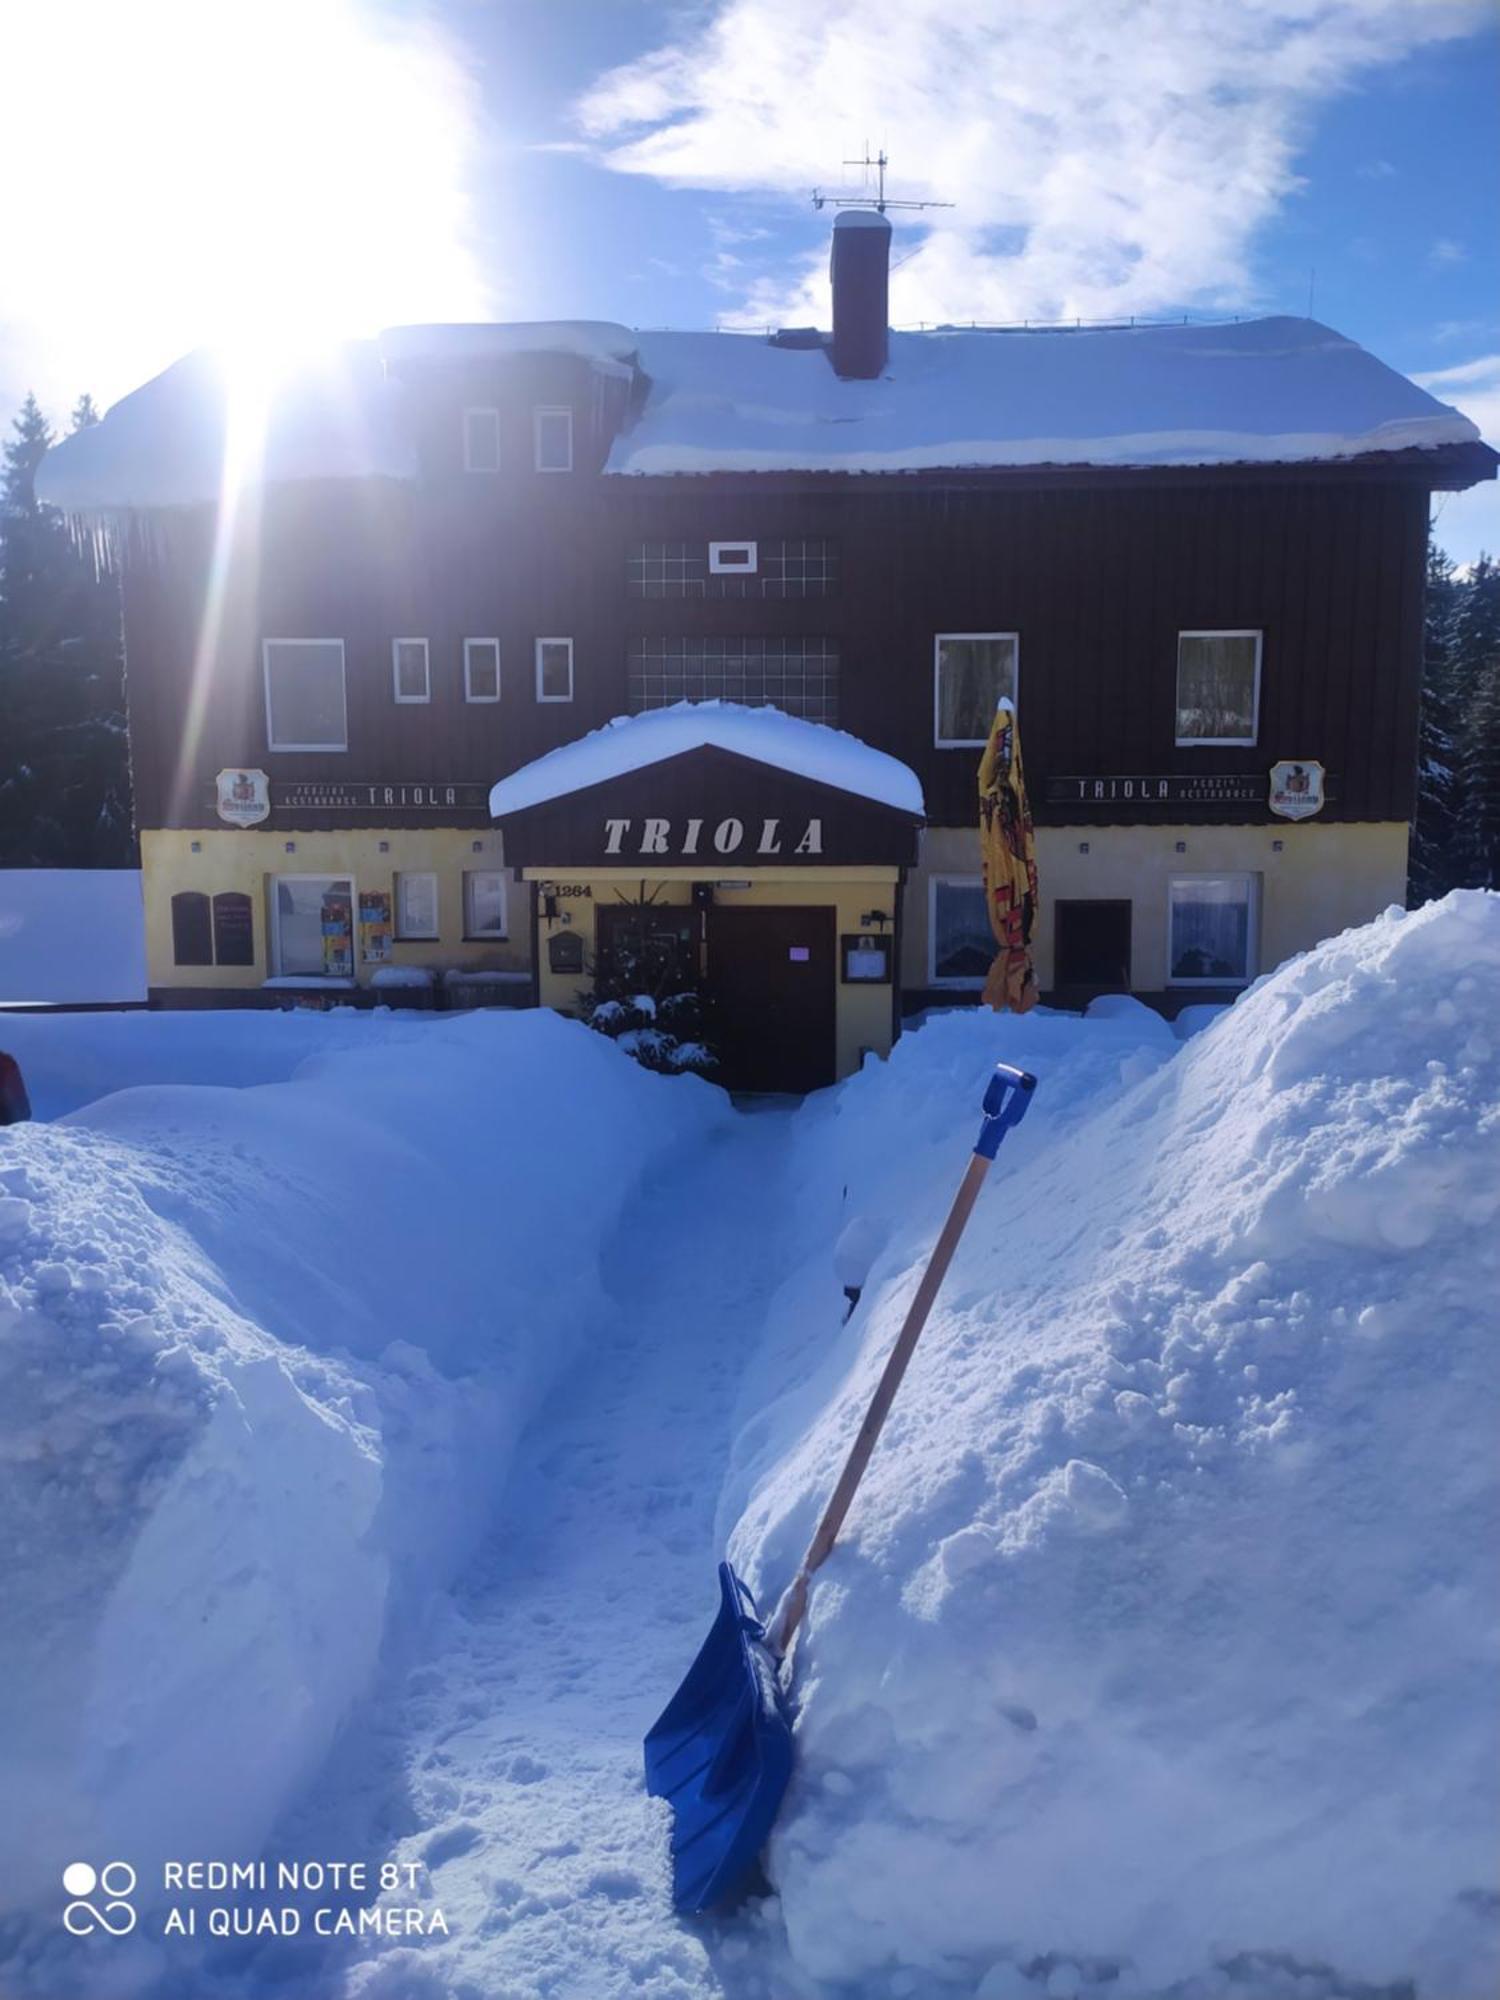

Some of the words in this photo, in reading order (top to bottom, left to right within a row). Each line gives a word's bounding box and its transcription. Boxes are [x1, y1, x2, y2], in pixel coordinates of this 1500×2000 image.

[368, 787, 456, 804] TRIOLA
[1078, 780, 1168, 798] TRIOLA
[604, 817, 823, 853] TRIOLA
[555, 885, 593, 897] 1264
